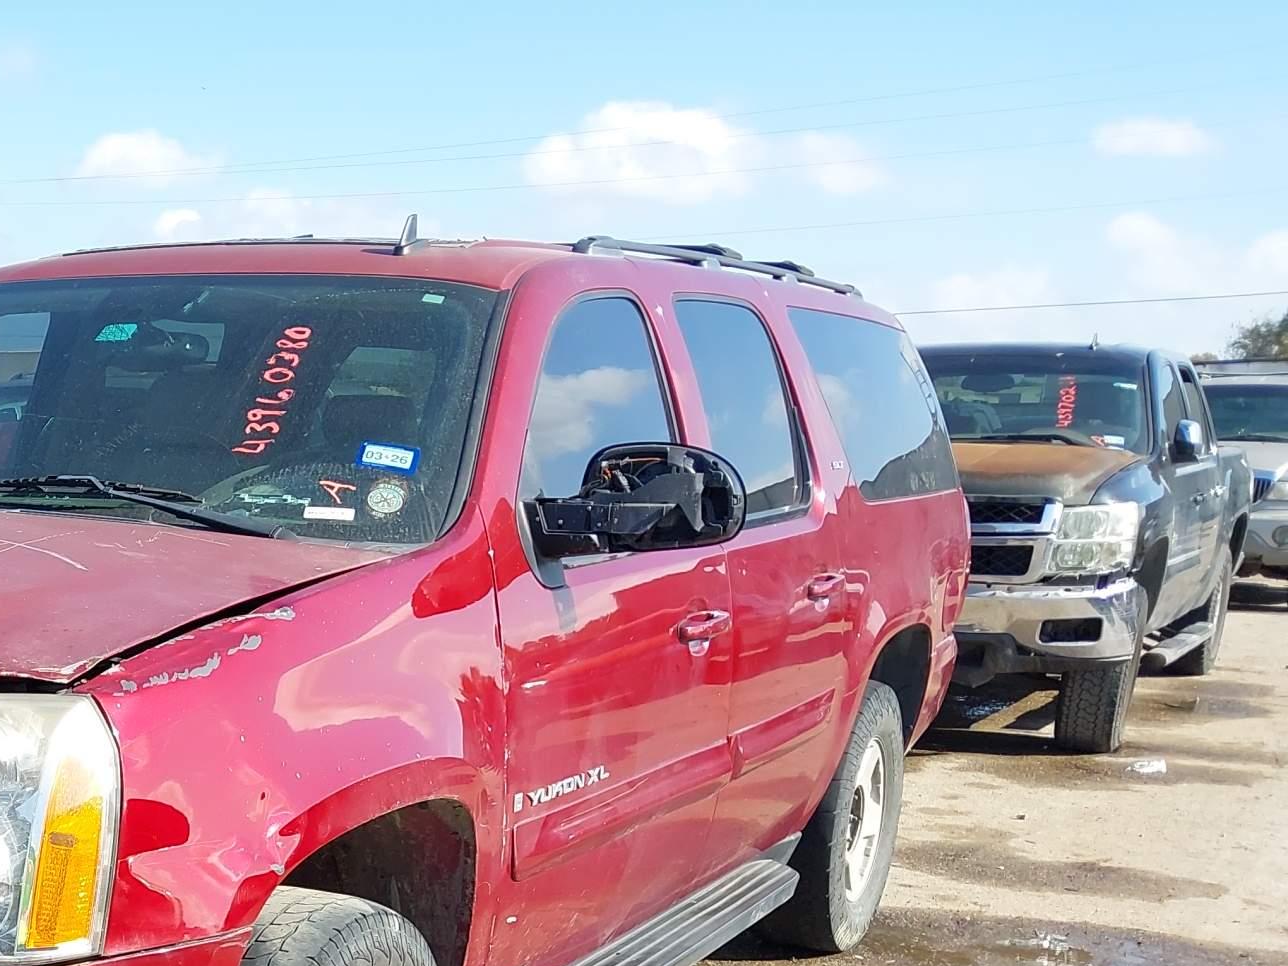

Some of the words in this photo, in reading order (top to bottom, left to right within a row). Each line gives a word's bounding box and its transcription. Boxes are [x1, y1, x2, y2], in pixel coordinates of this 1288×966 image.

[231, 326, 312, 453] 43960380
[365, 450, 383, 460] 03
[390, 454, 409, 465] 26
[319, 479, 357, 505] A
[526, 772, 586, 807] YUKON
[586, 765, 610, 787] XL
